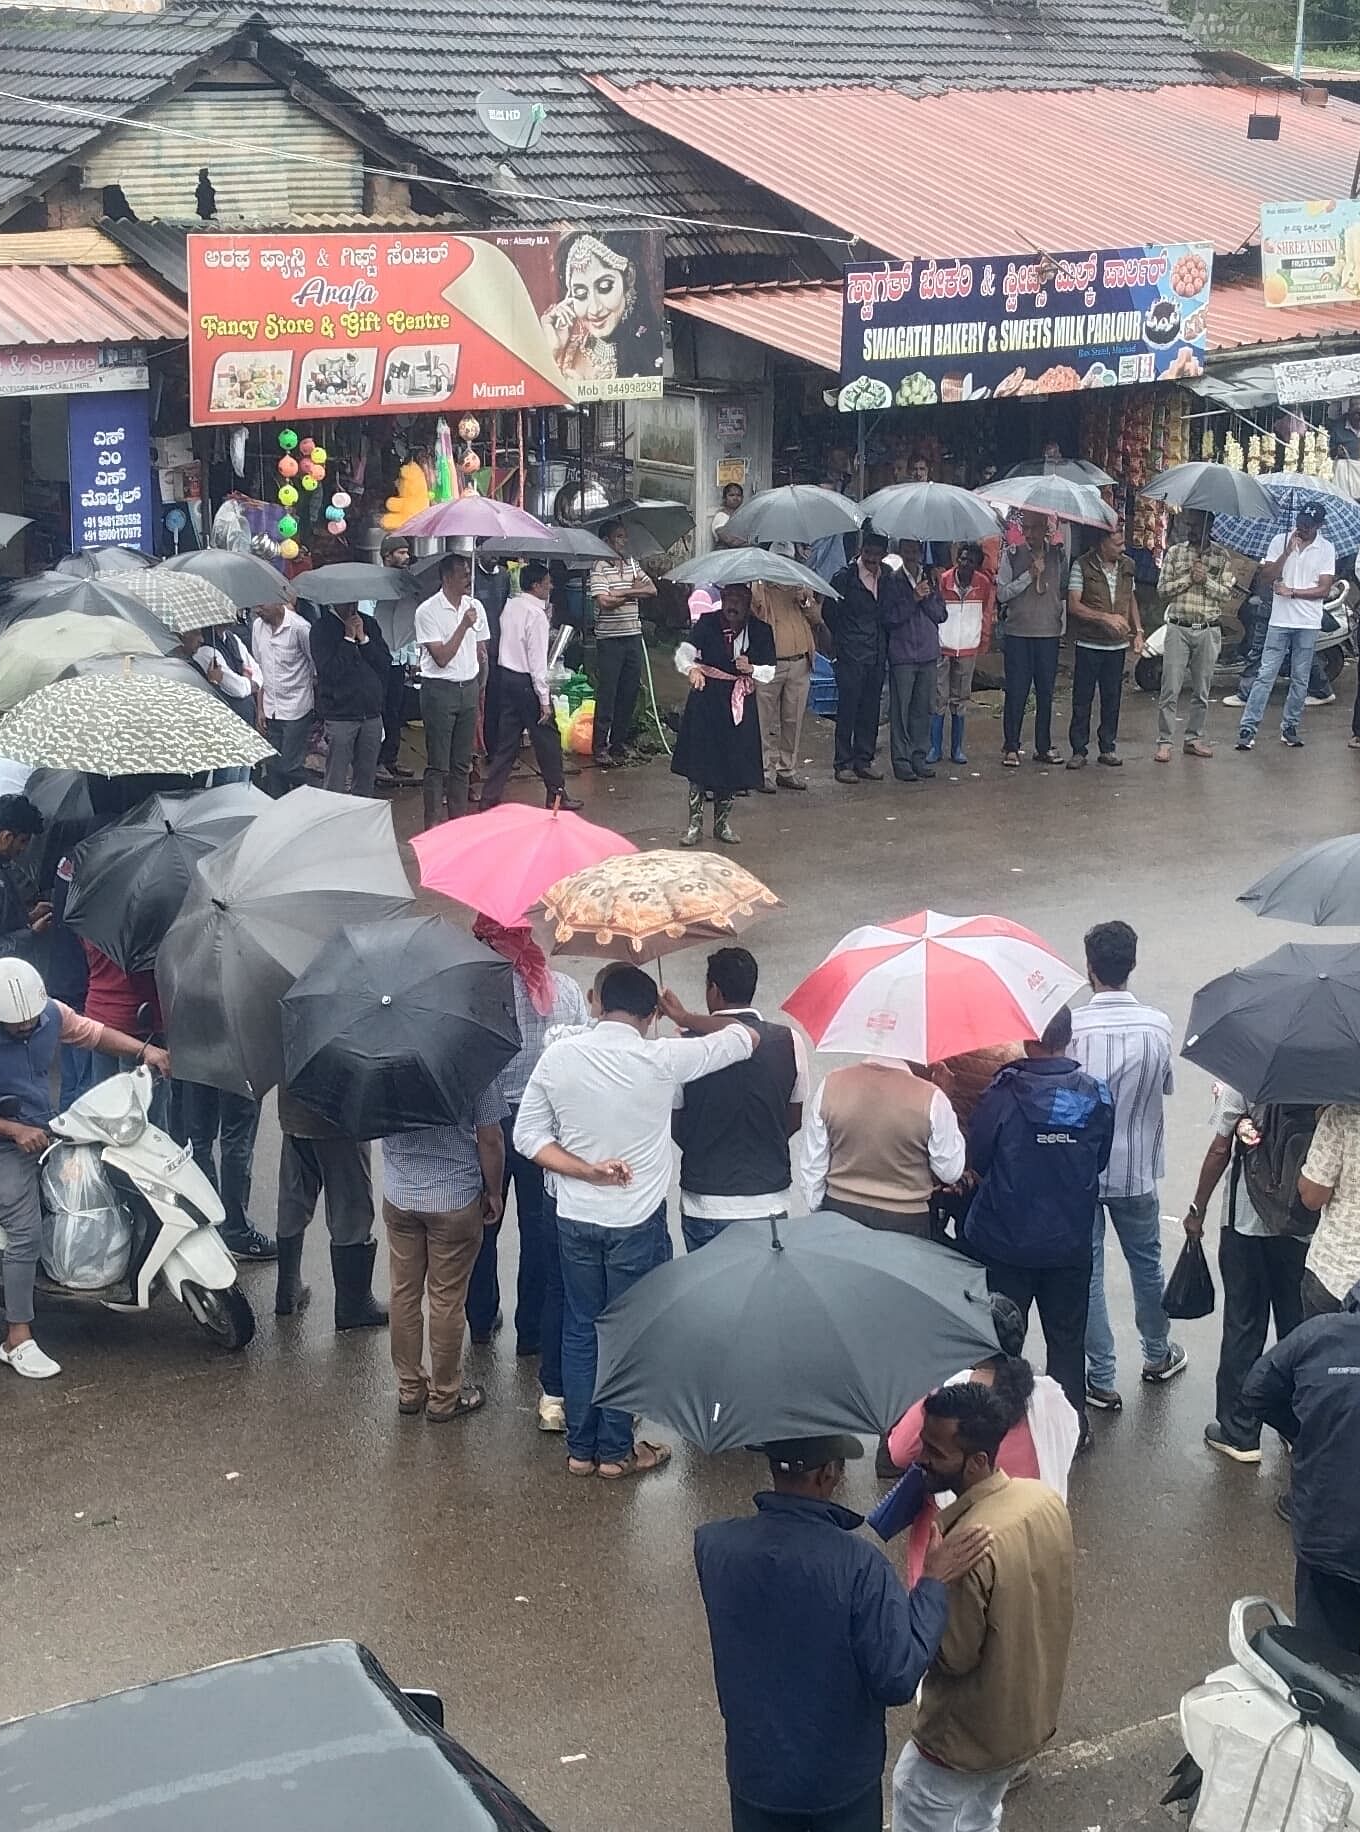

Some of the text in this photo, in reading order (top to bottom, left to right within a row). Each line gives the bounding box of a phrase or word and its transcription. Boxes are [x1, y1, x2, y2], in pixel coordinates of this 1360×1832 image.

[260, 246, 306, 279] ಫ್ಯಾನ್ಸಿ
[316, 247, 330, 269] &
[387, 240, 449, 265] ಸೆಂಟರ್
[1276, 239, 1339, 255] SHREE VISHN
[291, 276, 378, 311] Arafa
[847, 261, 912, 321] ಸ್ವಾಗತ್
[919, 258, 973, 300] ಬೇಕರಿ
[980, 264, 996, 297] &
[200, 309, 451, 341] Fancy Store & Gift Centre
[862, 310, 1141, 361] SWAGATH BAKERY & SWEETS MILK PARLOUR
[8, 354, 26, 377] &
[29, 352, 97, 376] Service
[472, 379, 525, 399] Murnad
[577, 385, 599, 397] Mob
[93, 427, 126, 446] ಎಸ್
[98, 450, 122, 466] ಎಂ
[95, 467, 127, 486] ಎಸ್
[80, 486, 142, 513] ಮೊಬೈಲ್
